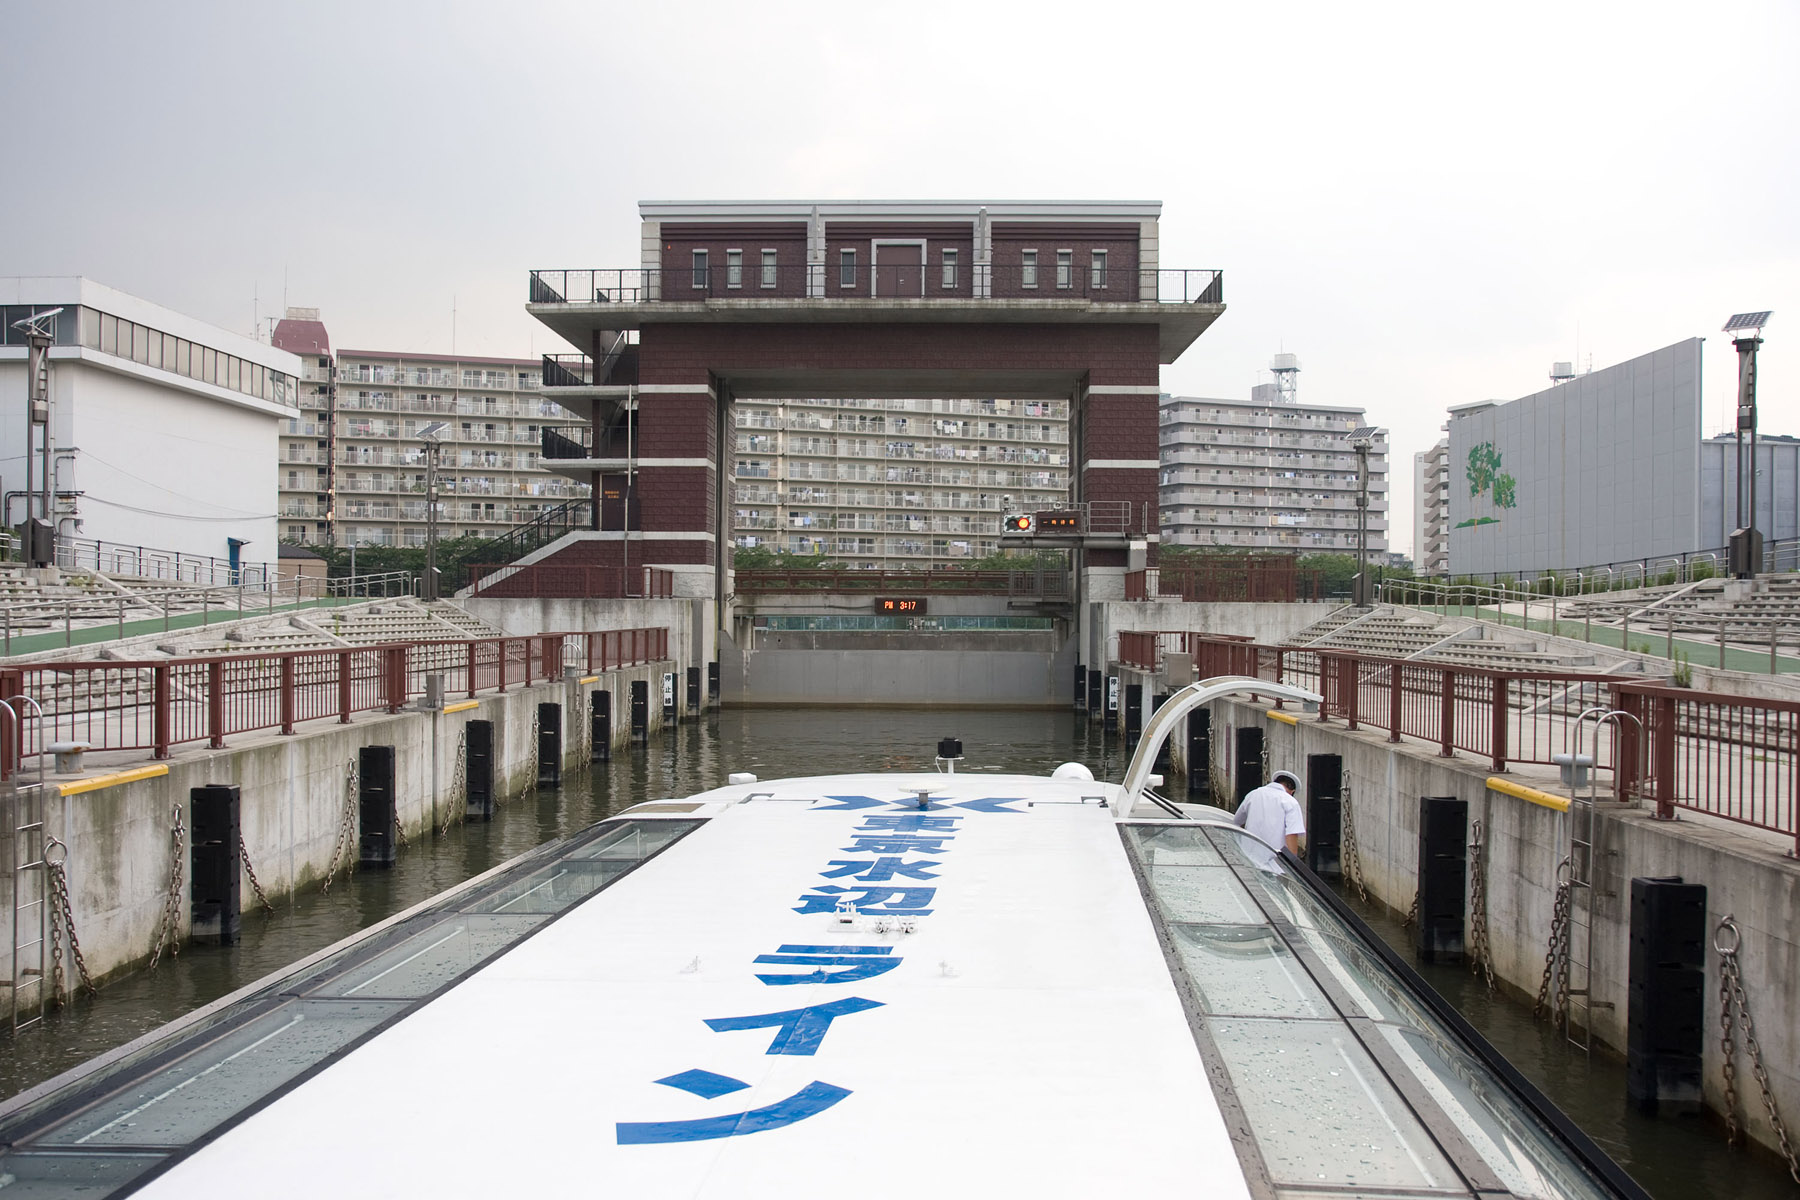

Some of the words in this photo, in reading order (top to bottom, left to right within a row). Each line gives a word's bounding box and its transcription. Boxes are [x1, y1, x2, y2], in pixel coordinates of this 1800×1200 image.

[884, 601, 894, 609] PM
[899, 601, 916, 610] 3:17
[616, 815, 964, 1145] 東京水辺ライン
